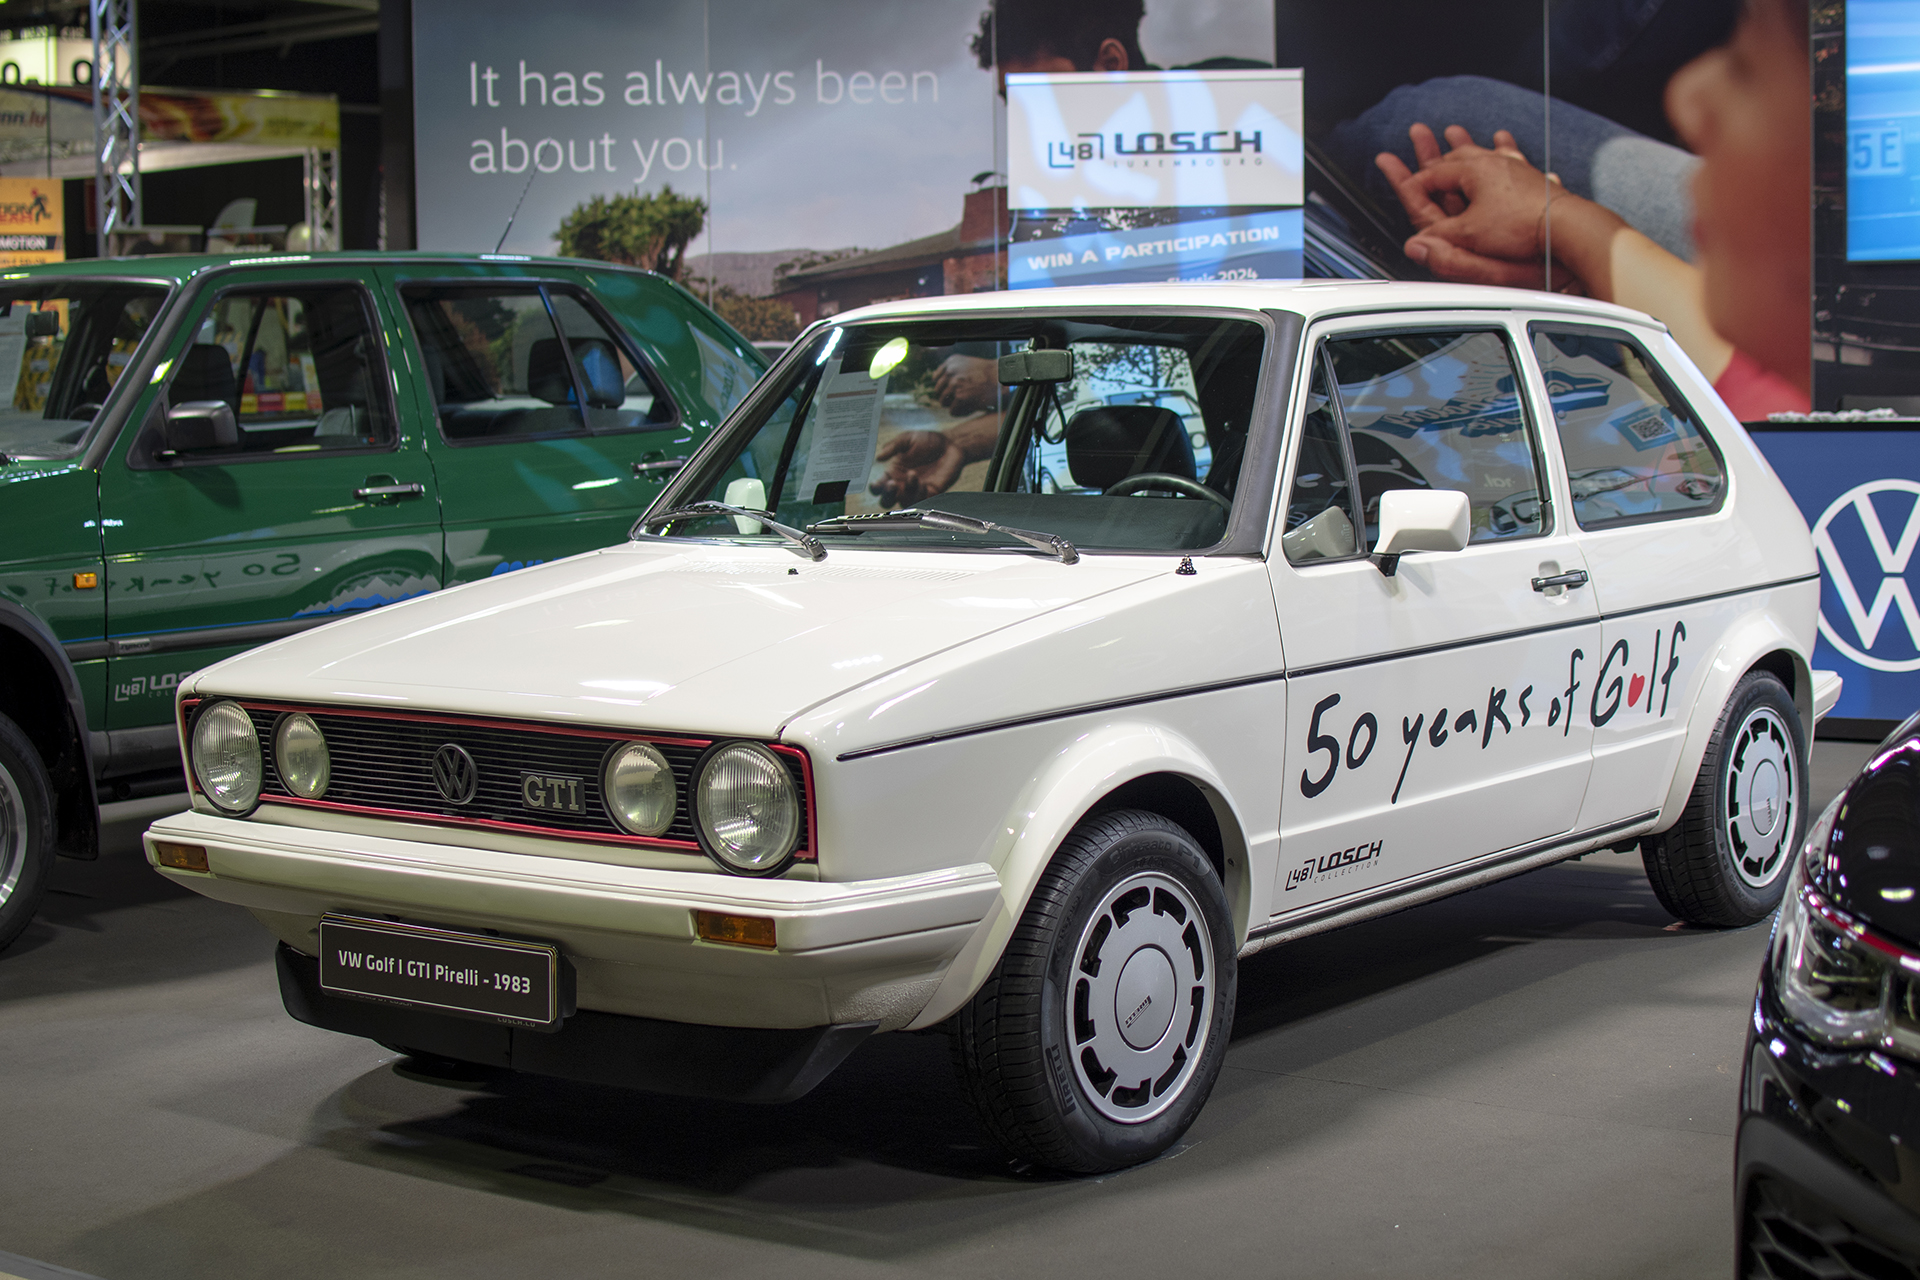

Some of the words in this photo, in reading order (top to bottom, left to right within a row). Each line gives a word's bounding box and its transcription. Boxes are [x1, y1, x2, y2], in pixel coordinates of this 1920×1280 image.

[470, 61, 500, 107] It
[519, 59, 606, 106] has
[623, 58, 796, 116] always
[816, 58, 939, 104] been
[469, 126, 617, 174] about
[631, 137, 739, 183] you.
[1113, 158, 1262, 168] LUXEMBOURG
[1115, 131, 1262, 155] LOSCH
[1027, 251, 1074, 270] WIN
[1080, 249, 1099, 265] A
[1105, 226, 1279, 261] PARTICIPATION
[1300, 693, 1378, 799] 50
[1547, 648, 1584, 737] of
[523, 774, 581, 812] GTI
[1313, 860, 1379, 884] COLLECTION
[1317, 839, 1383, 873] LOSCH
[338, 950, 362, 968] VW
[365, 954, 394, 973] Golf
[407, 960, 430, 979] GTI
[435, 964, 478, 986] Pirelli
[494, 973, 531, 994] 1983
